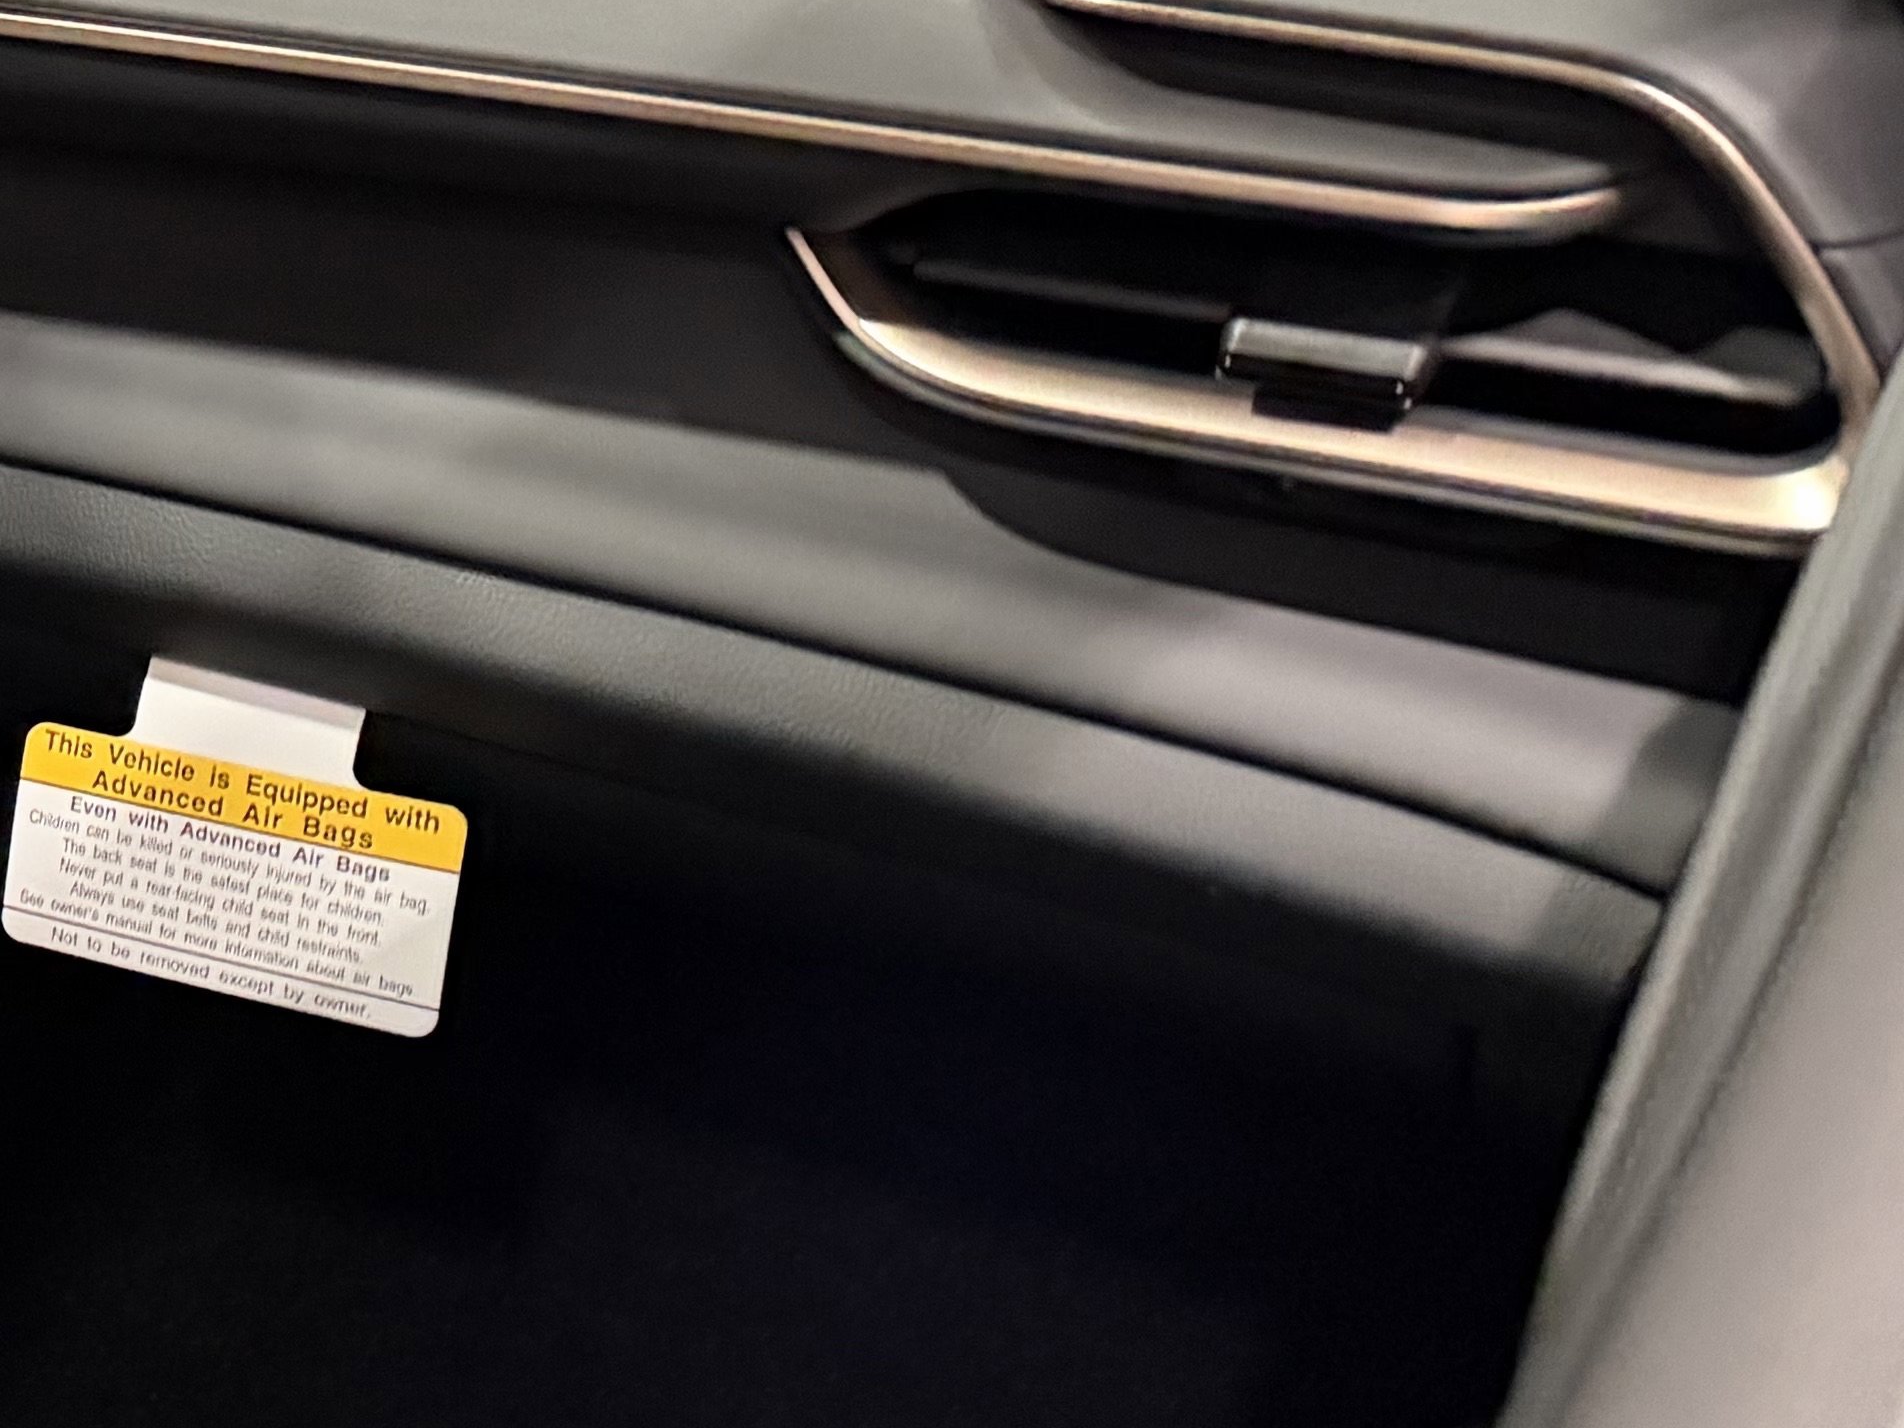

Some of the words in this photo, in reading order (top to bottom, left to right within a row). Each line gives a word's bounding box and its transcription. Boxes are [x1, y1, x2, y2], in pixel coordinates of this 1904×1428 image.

[44, 729, 93, 758] This
[109, 743, 194, 780] Vehicle
[211, 767, 230, 789] is
[246, 774, 367, 822] Equipped
[385, 803, 439, 834] with
[94, 769, 223, 816] Advanced
[244, 803, 283, 829] Air
[304, 815, 373, 851] Bags
[30, 809, 79, 833] Children
[87, 823, 109, 840] can
[118, 830, 131, 844] be
[141, 834, 171, 854] killed
[181, 844, 193, 858] or
[201, 848, 259, 877] seriously
[267, 862, 311, 888] injured
[320, 875, 336, 894] by
[344, 881, 364, 899] the
[375, 888, 391, 904] air
[63, 837, 85, 856] The
[94, 845, 122, 864] back
[131, 855, 156, 872] seat
[165, 861, 175, 876] is
[184, 865, 202, 883] the
[212, 872, 250, 893] safest
[258, 882, 292, 906] place
[302, 891, 319, 908] for
[72, 796, 116, 820] Even
[129, 810, 168, 833] with
[181, 821, 280, 857] Advanced
[294, 846, 322, 866] Air
[337, 855, 389, 884] Bags
[20, 888, 43, 907] See
[52, 897, 99, 921] owner's
[107, 910, 151, 933] manual
[160, 922, 177, 939] for
[185, 930, 217, 948] more
[225, 937, 299, 969] information
[307, 958, 344, 979] about
[354, 969, 370, 985] air
[60, 858, 95, 879] Never
[104, 870, 122, 888] put
[131, 877, 137, 889] a
[223, 895, 252, 915] child
[261, 905, 288, 924] seat
[298, 913, 308, 929] in
[318, 917, 338, 935] the
[70, 880, 114, 905] Always
[122, 895, 144, 911] use
[153, 902, 178, 919] seat
[187, 909, 217, 929] belts
[227, 918, 249, 937] and
[258, 925, 289, 946] child
[52, 925, 77, 946] Not
[87, 934, 101, 952] to
[112, 941, 130, 959] be
[141, 948, 209, 978] removed
[220, 967, 273, 994] except
[284, 983, 304, 1004] by
